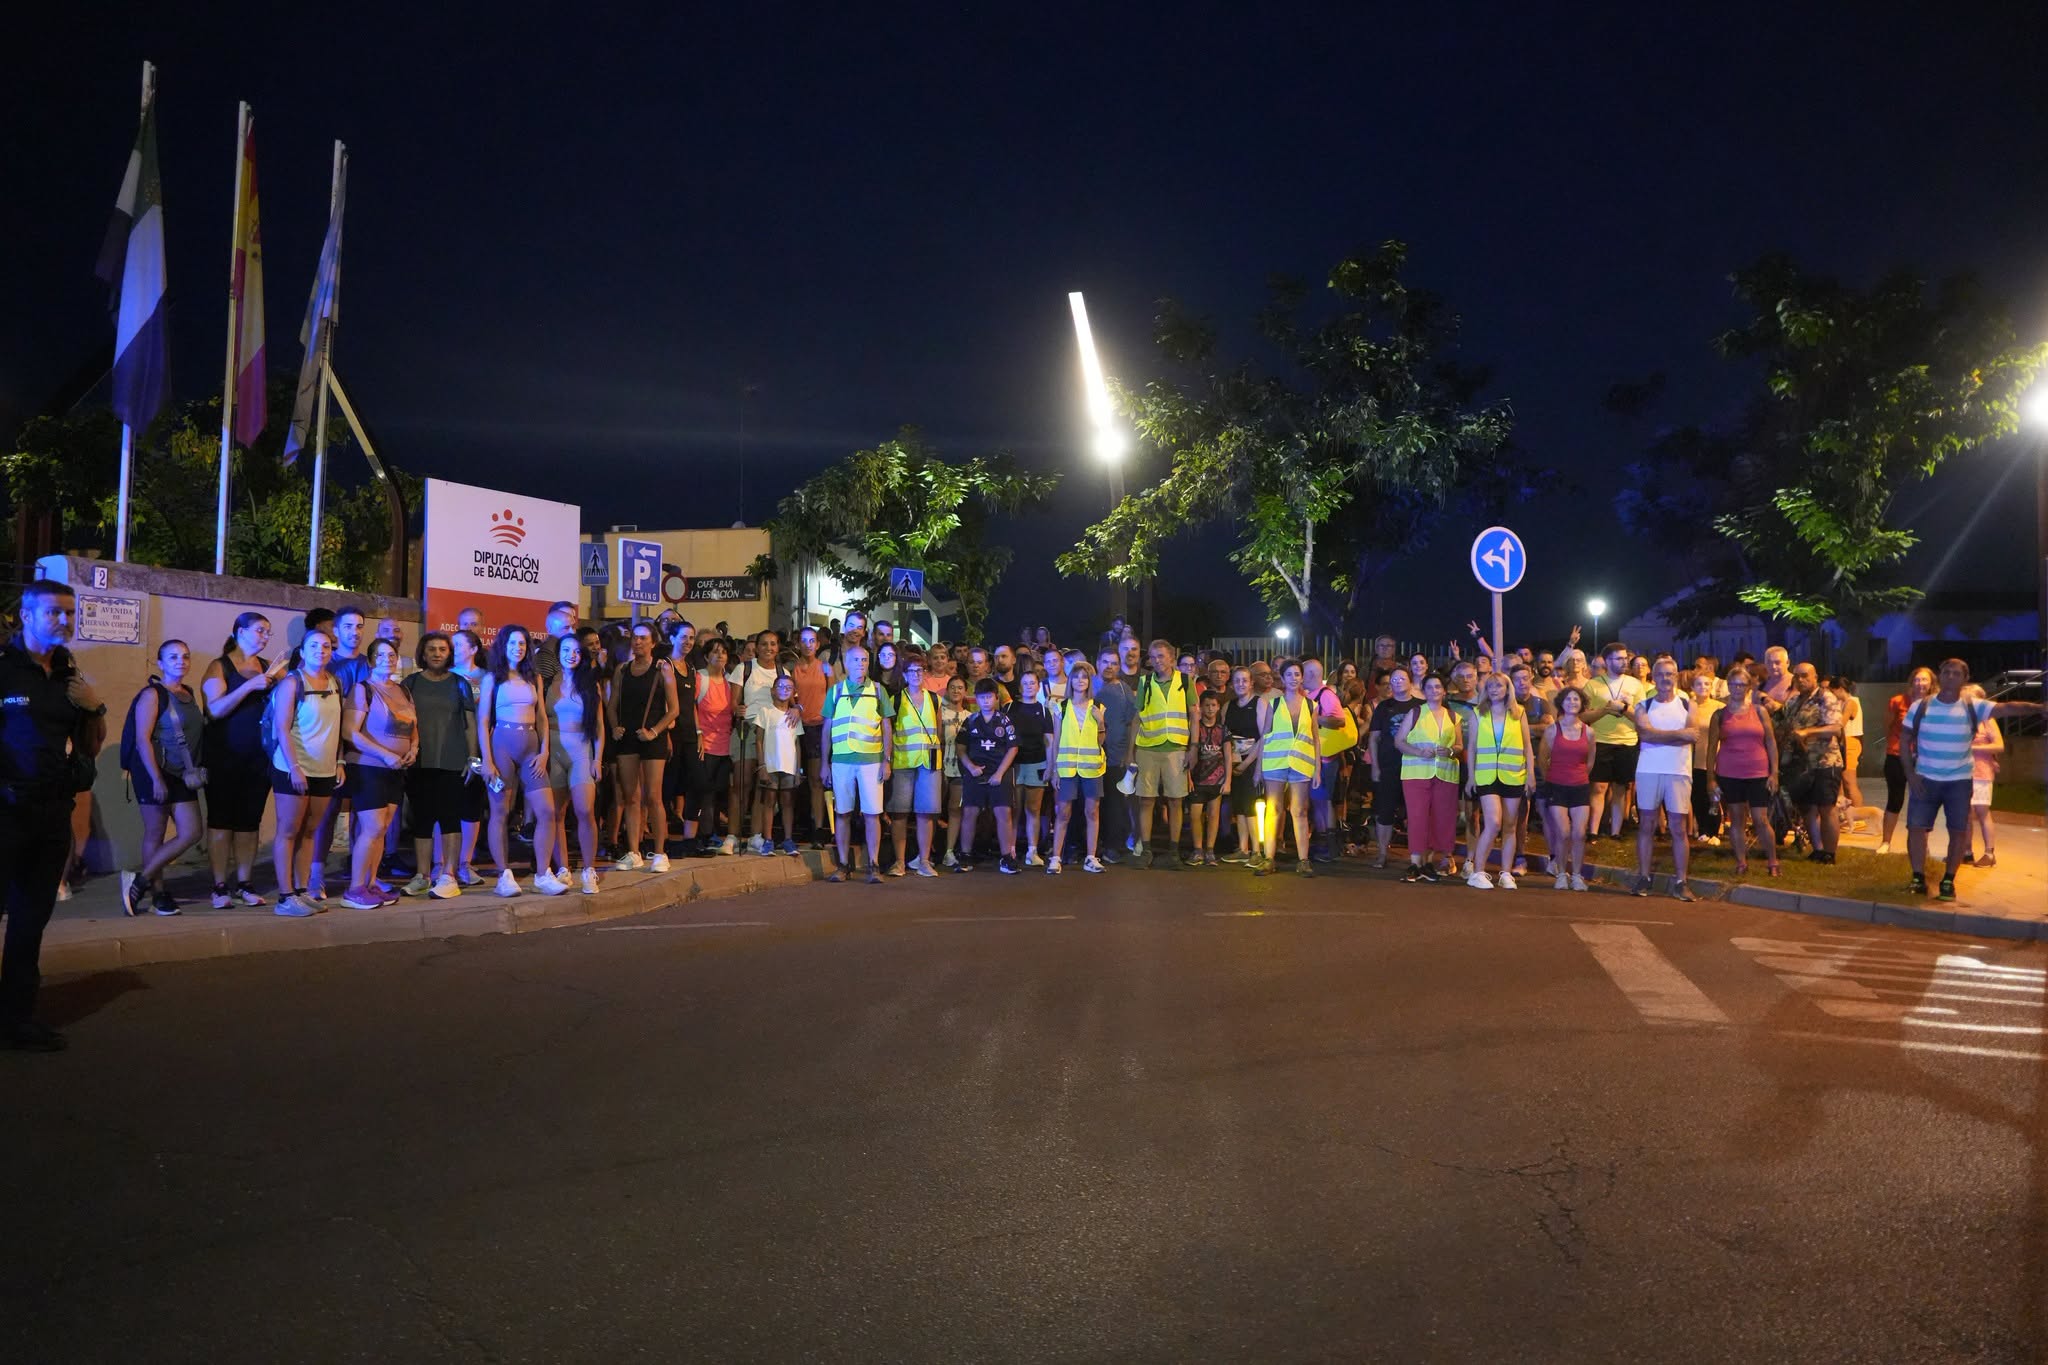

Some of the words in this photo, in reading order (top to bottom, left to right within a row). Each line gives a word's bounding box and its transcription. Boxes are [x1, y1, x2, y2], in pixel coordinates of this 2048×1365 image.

[474, 550, 539, 570] DIPUTACIÓN
[99, 569, 106, 586] 2
[473, 566, 485, 577] DE
[487, 565, 539, 584] BADAJOZ
[633, 558, 651, 591] P
[696, 579, 714, 589] CAFÉ
[718, 579, 734, 588] BAR
[625, 590, 657, 601] PARKING
[690, 590, 700, 599] LA
[101, 606, 133, 615] AVENIDA
[487, 627, 497, 636] DE
